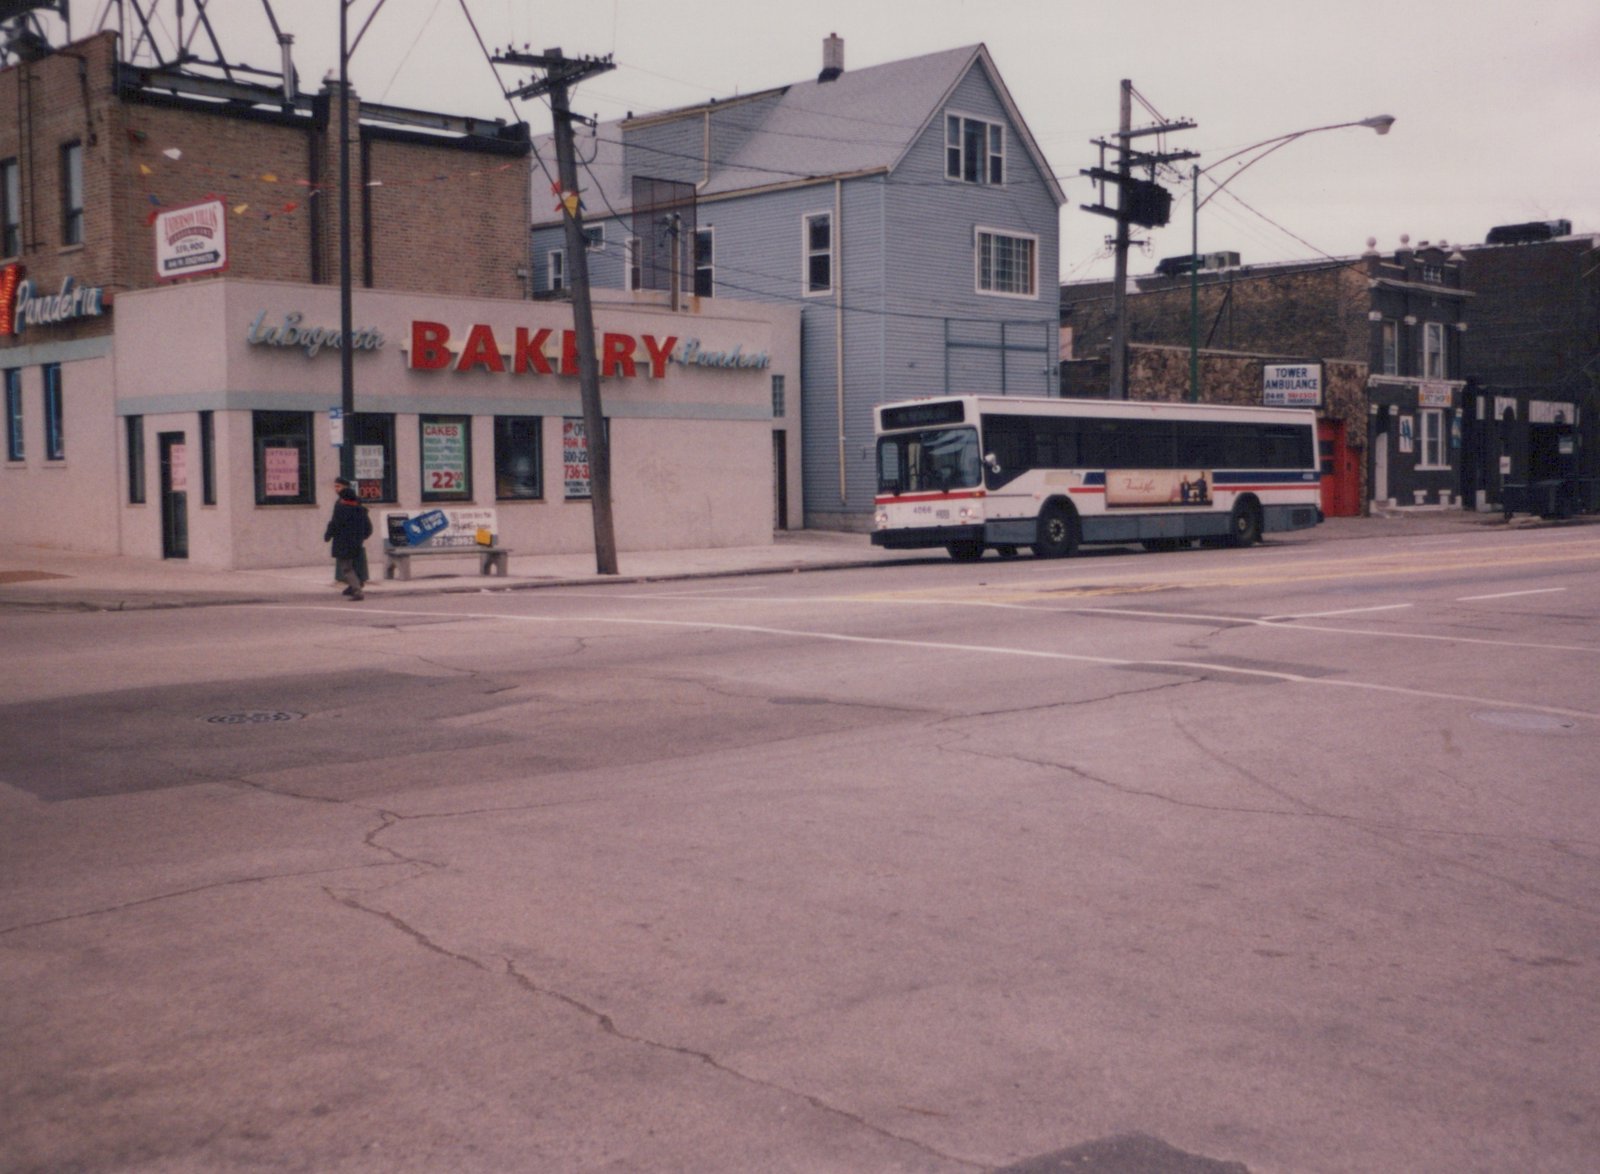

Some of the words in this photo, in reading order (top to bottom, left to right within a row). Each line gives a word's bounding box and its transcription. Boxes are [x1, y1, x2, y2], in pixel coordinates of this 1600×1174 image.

[1275, 367, 1308, 378] TOWER
[1264, 379, 1318, 391] AMBULANCE
[425, 425, 459, 437] CAKES
[359, 486, 383, 499] OPEN
